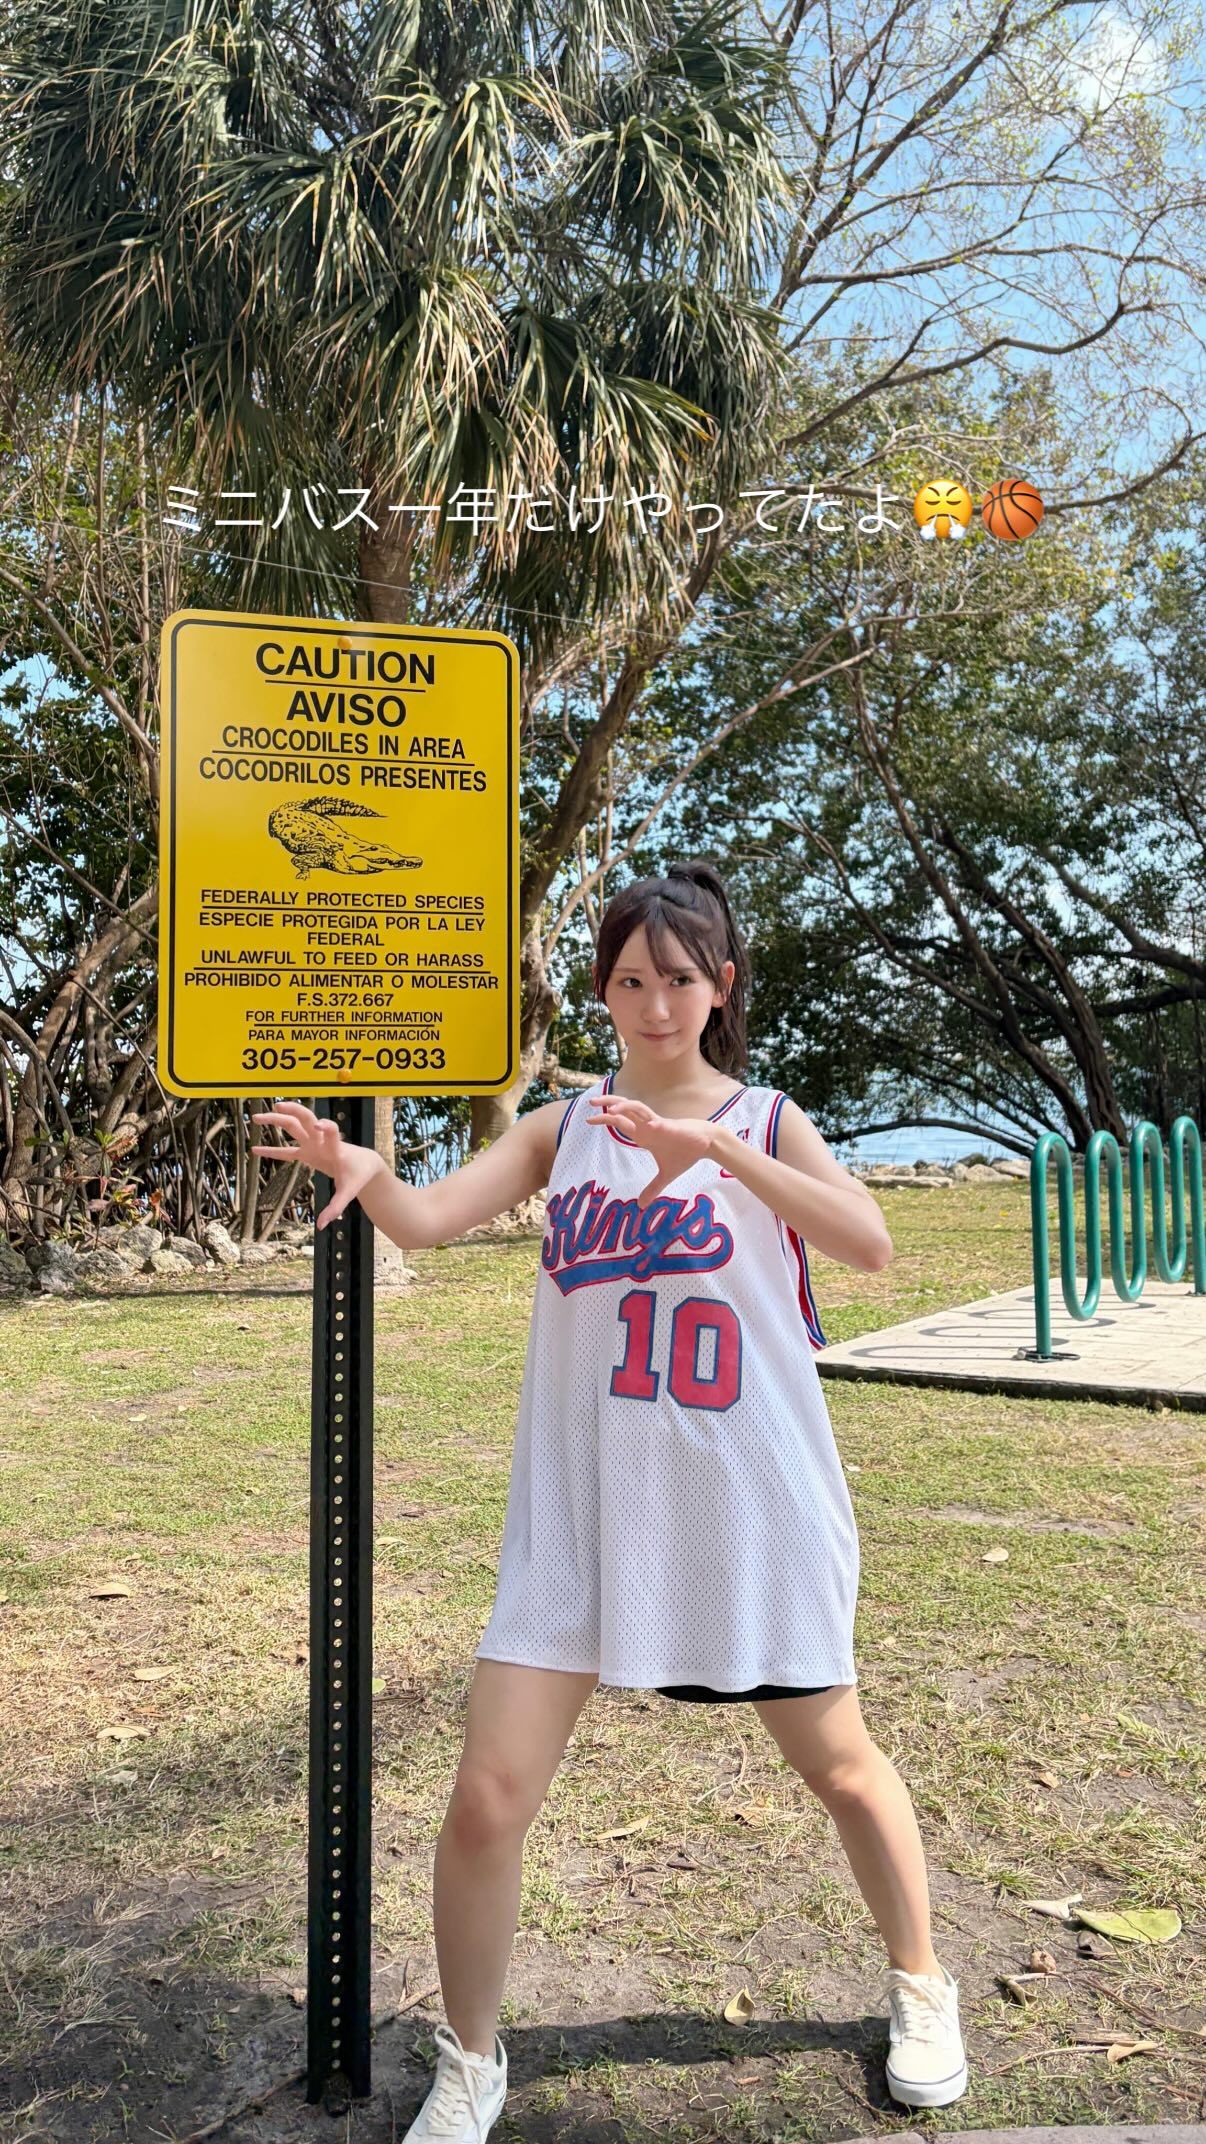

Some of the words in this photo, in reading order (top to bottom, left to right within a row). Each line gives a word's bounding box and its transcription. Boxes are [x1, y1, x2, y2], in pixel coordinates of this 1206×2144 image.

[256, 642, 435, 685] CAUTION
[286, 690, 407, 728] AVISO
[222, 725, 369, 755] CROCODILES
[379, 735, 399, 756] IN
[409, 736, 466, 759] AREA
[200, 756, 350, 786] COCODRILOS
[361, 766, 487, 792] PRESENTES
[200, 889, 300, 905] FEDERALLY
[306, 892, 408, 908] PROTECTED
[415, 895, 485, 910] SPECIES
[200, 912, 274, 928] ESPECIE
[282, 914, 378, 930] PROTEGIDA
[385, 916, 420, 931] POR
[427, 917, 449, 931] LA
[455, 918, 485, 932] LEY
[307, 932, 385, 947] FEDERAL
[201, 950, 296, 965] UNLAWFUL
[303, 952, 326, 966] TO
[334, 952, 377, 967] FEED
[385, 953, 409, 967] OR
[417, 954, 484, 968] HARASS
[184, 972, 281, 987] PROHIBIDO
[289, 974, 384, 988] ALIMENTAR
[391, 975, 404, 989] O
[411, 975, 499, 990] MOLESTAR
[297, 993, 394, 1007] F.S.372.667
[245, 1010, 275, 1022] FOR
[281, 1010, 345, 1023] FURTHER
[351, 1011, 443, 1023] INFORMATION
[248, 1029, 285, 1041] PARA
[291, 1029, 339, 1041] MAYOR
[345, 1027, 440, 1041] INFORMACIÓN
[241, 1048, 446, 1070] 305-257-0933
[541, 1180, 734, 1290] Kings
[609, 1288, 743, 1413] 10
